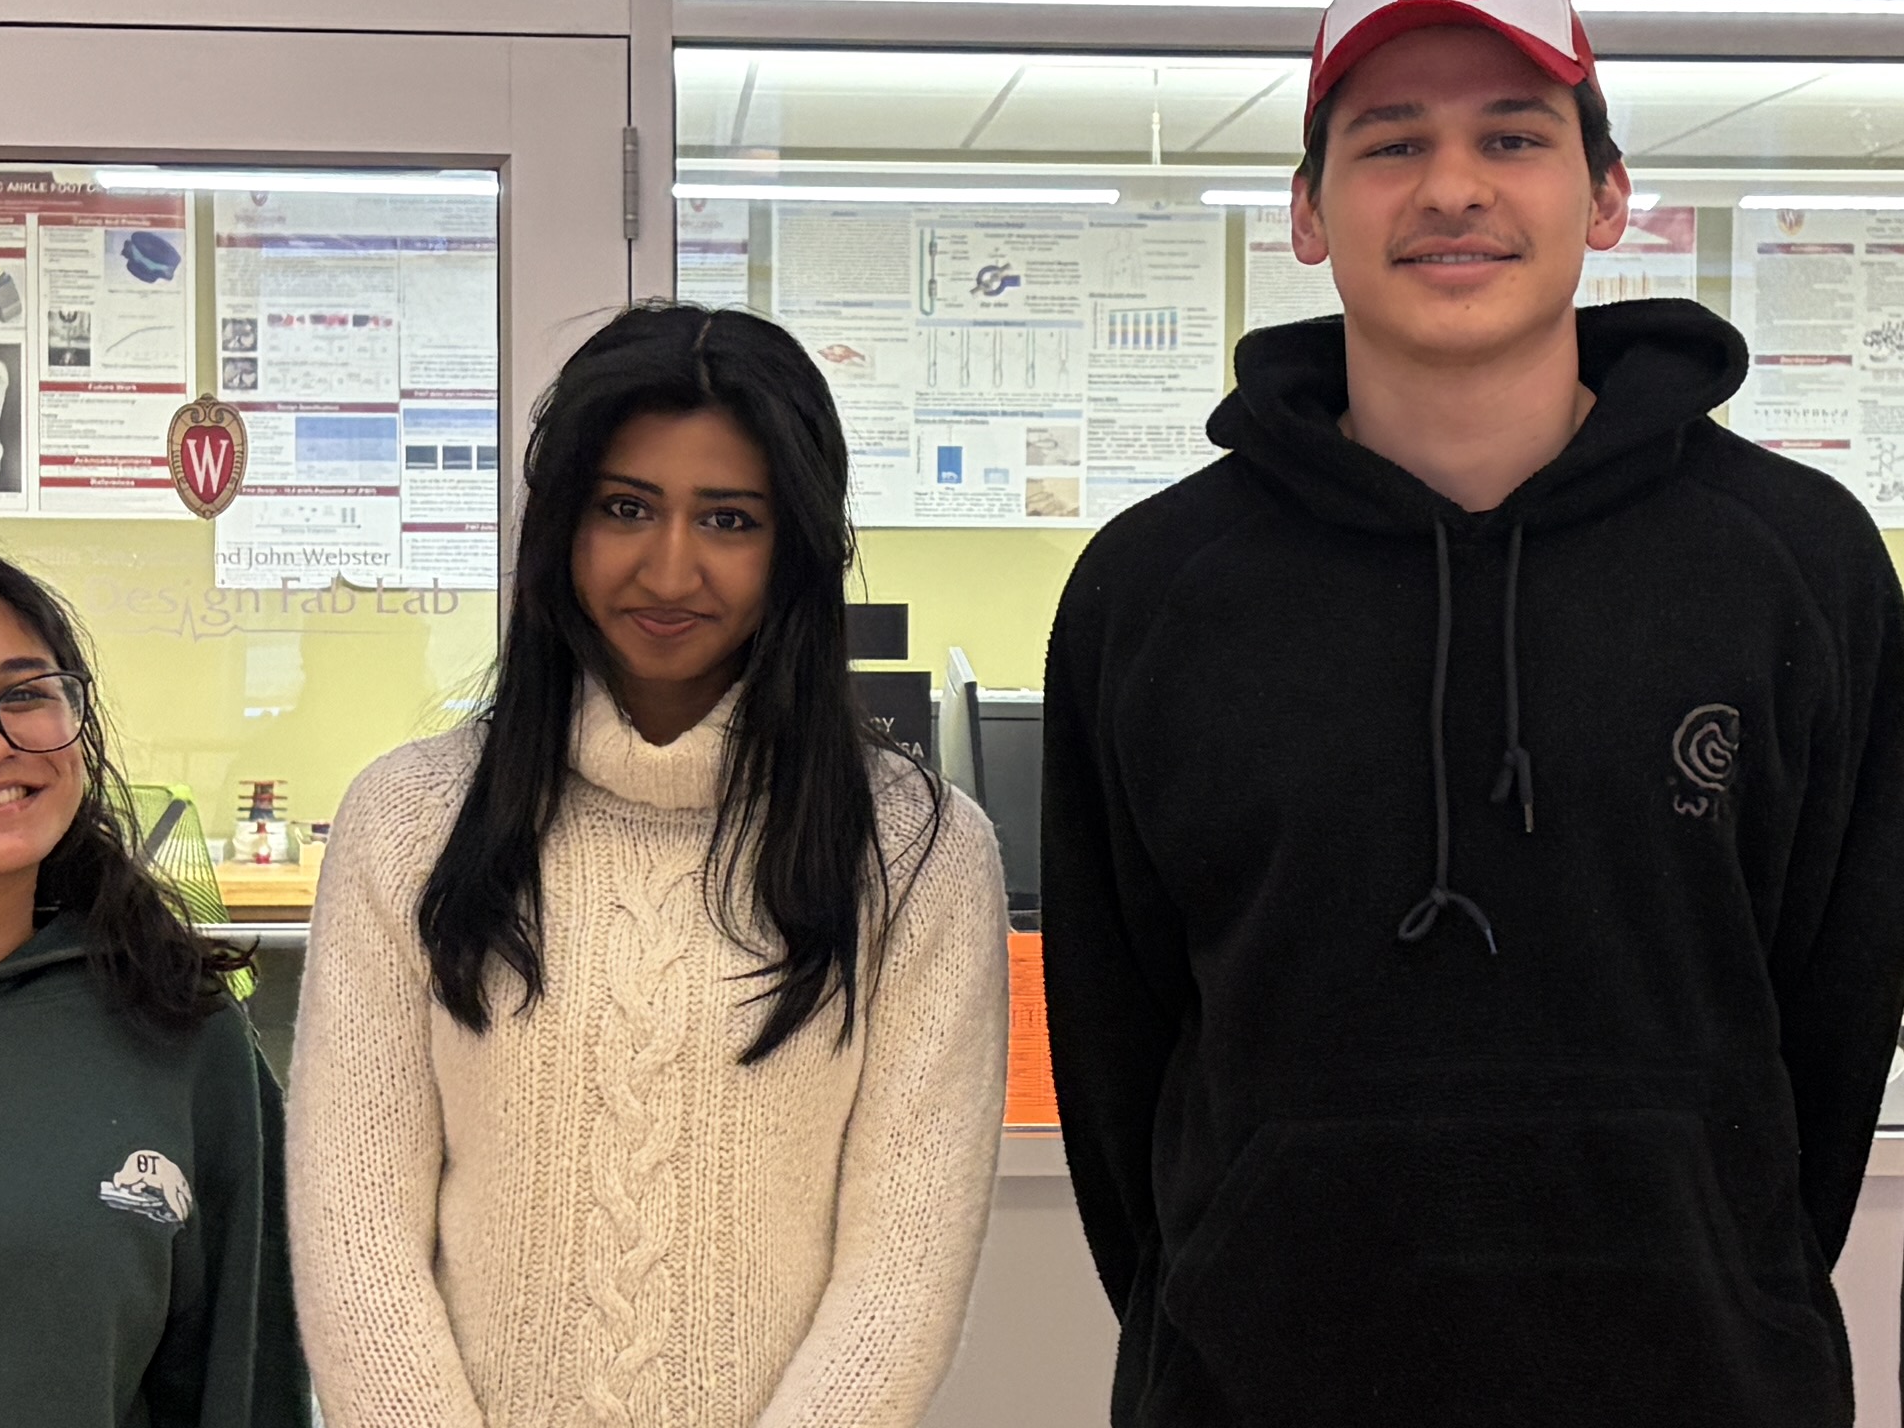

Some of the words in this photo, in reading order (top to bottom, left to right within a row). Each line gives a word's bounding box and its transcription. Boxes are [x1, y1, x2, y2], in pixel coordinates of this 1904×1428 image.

[7, 181, 48, 194] ANKLE
[186, 436, 230, 494] W
[246, 547, 295, 570] John
[303, 547, 391, 567] Webster
[86, 577, 261, 626] Design
[281, 577, 356, 614] Fab
[376, 577, 459, 615] Lab
